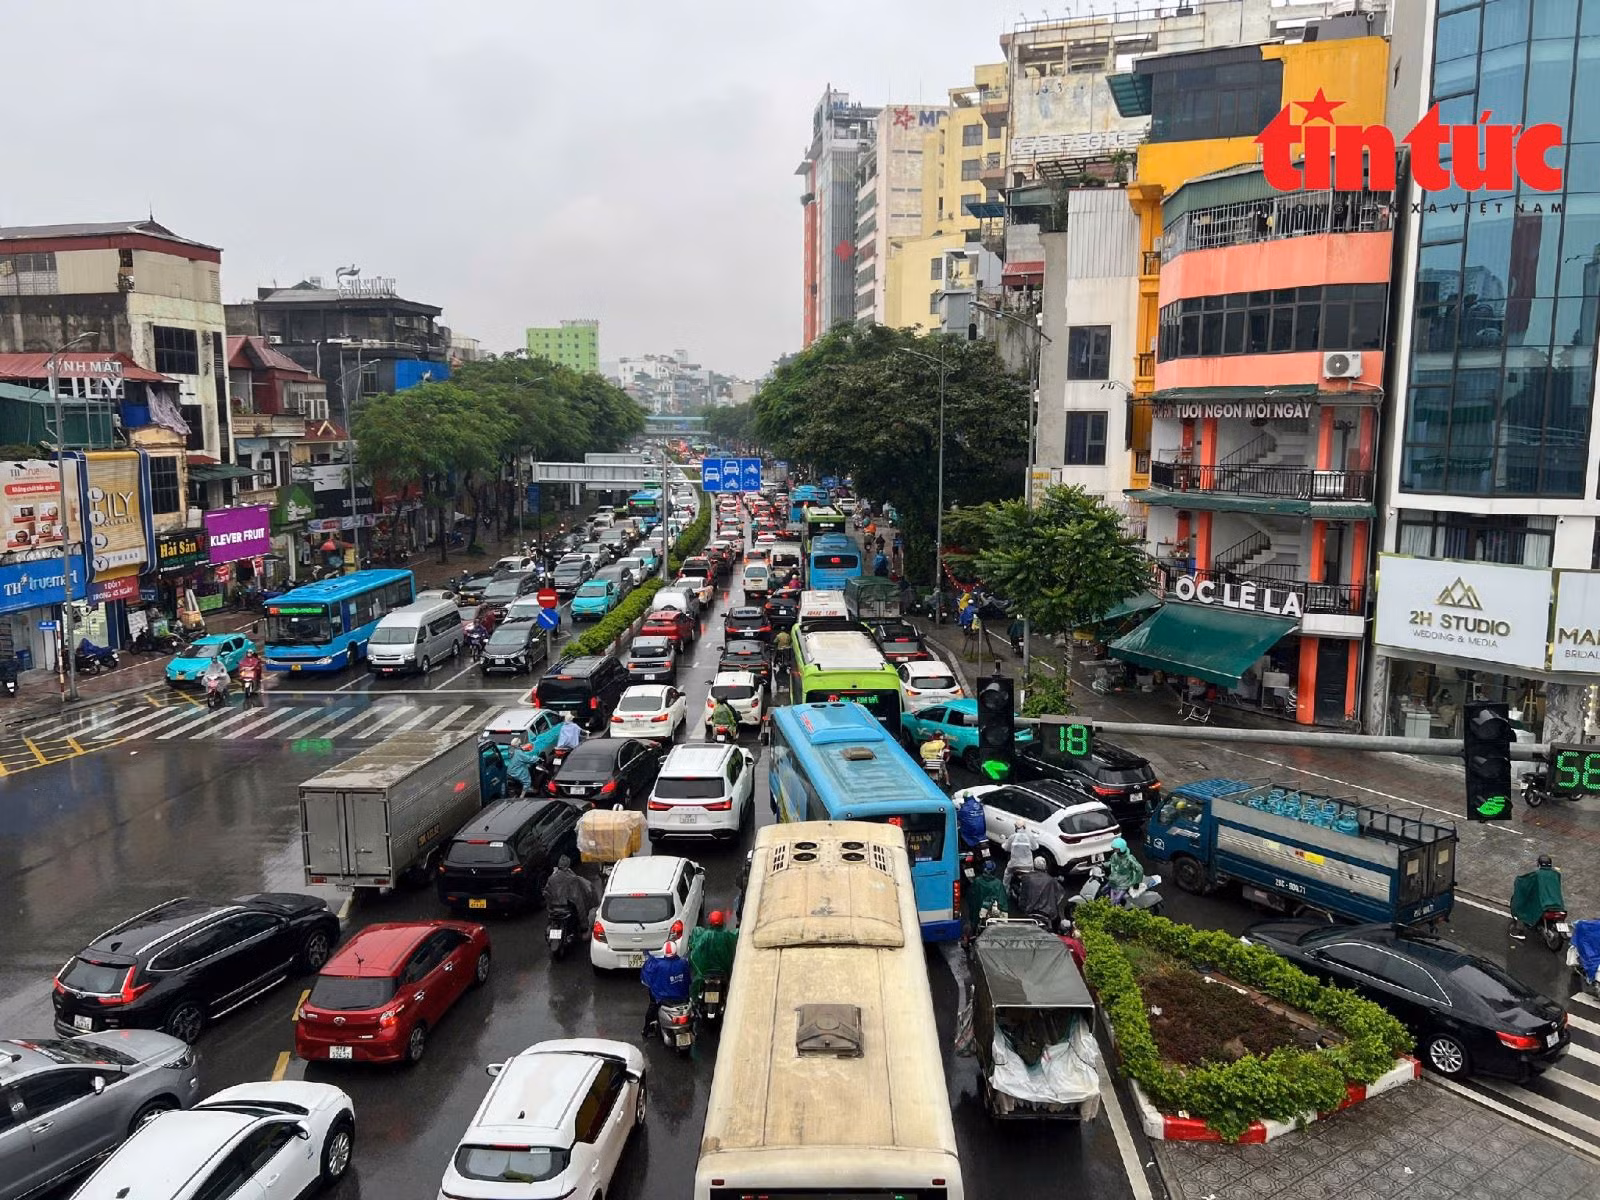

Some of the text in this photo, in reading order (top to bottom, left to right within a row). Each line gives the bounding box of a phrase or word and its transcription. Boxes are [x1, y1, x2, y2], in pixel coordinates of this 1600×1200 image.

[48, 376, 123, 399] LILY
[1205, 404, 1242, 418] NGON
[210, 530, 242, 546] KLEVER
[243, 528, 265, 541] FRUIT
[4, 582, 20, 596] TH
[1175, 572, 1302, 617] ỐC LÊ LA
[1409, 610, 1510, 637] 2H STUDIO
[1413, 629, 1498, 648] WEDDING & MEDIA
[1558, 627, 1600, 646] MA
[1059, 723, 1088, 756] 18
